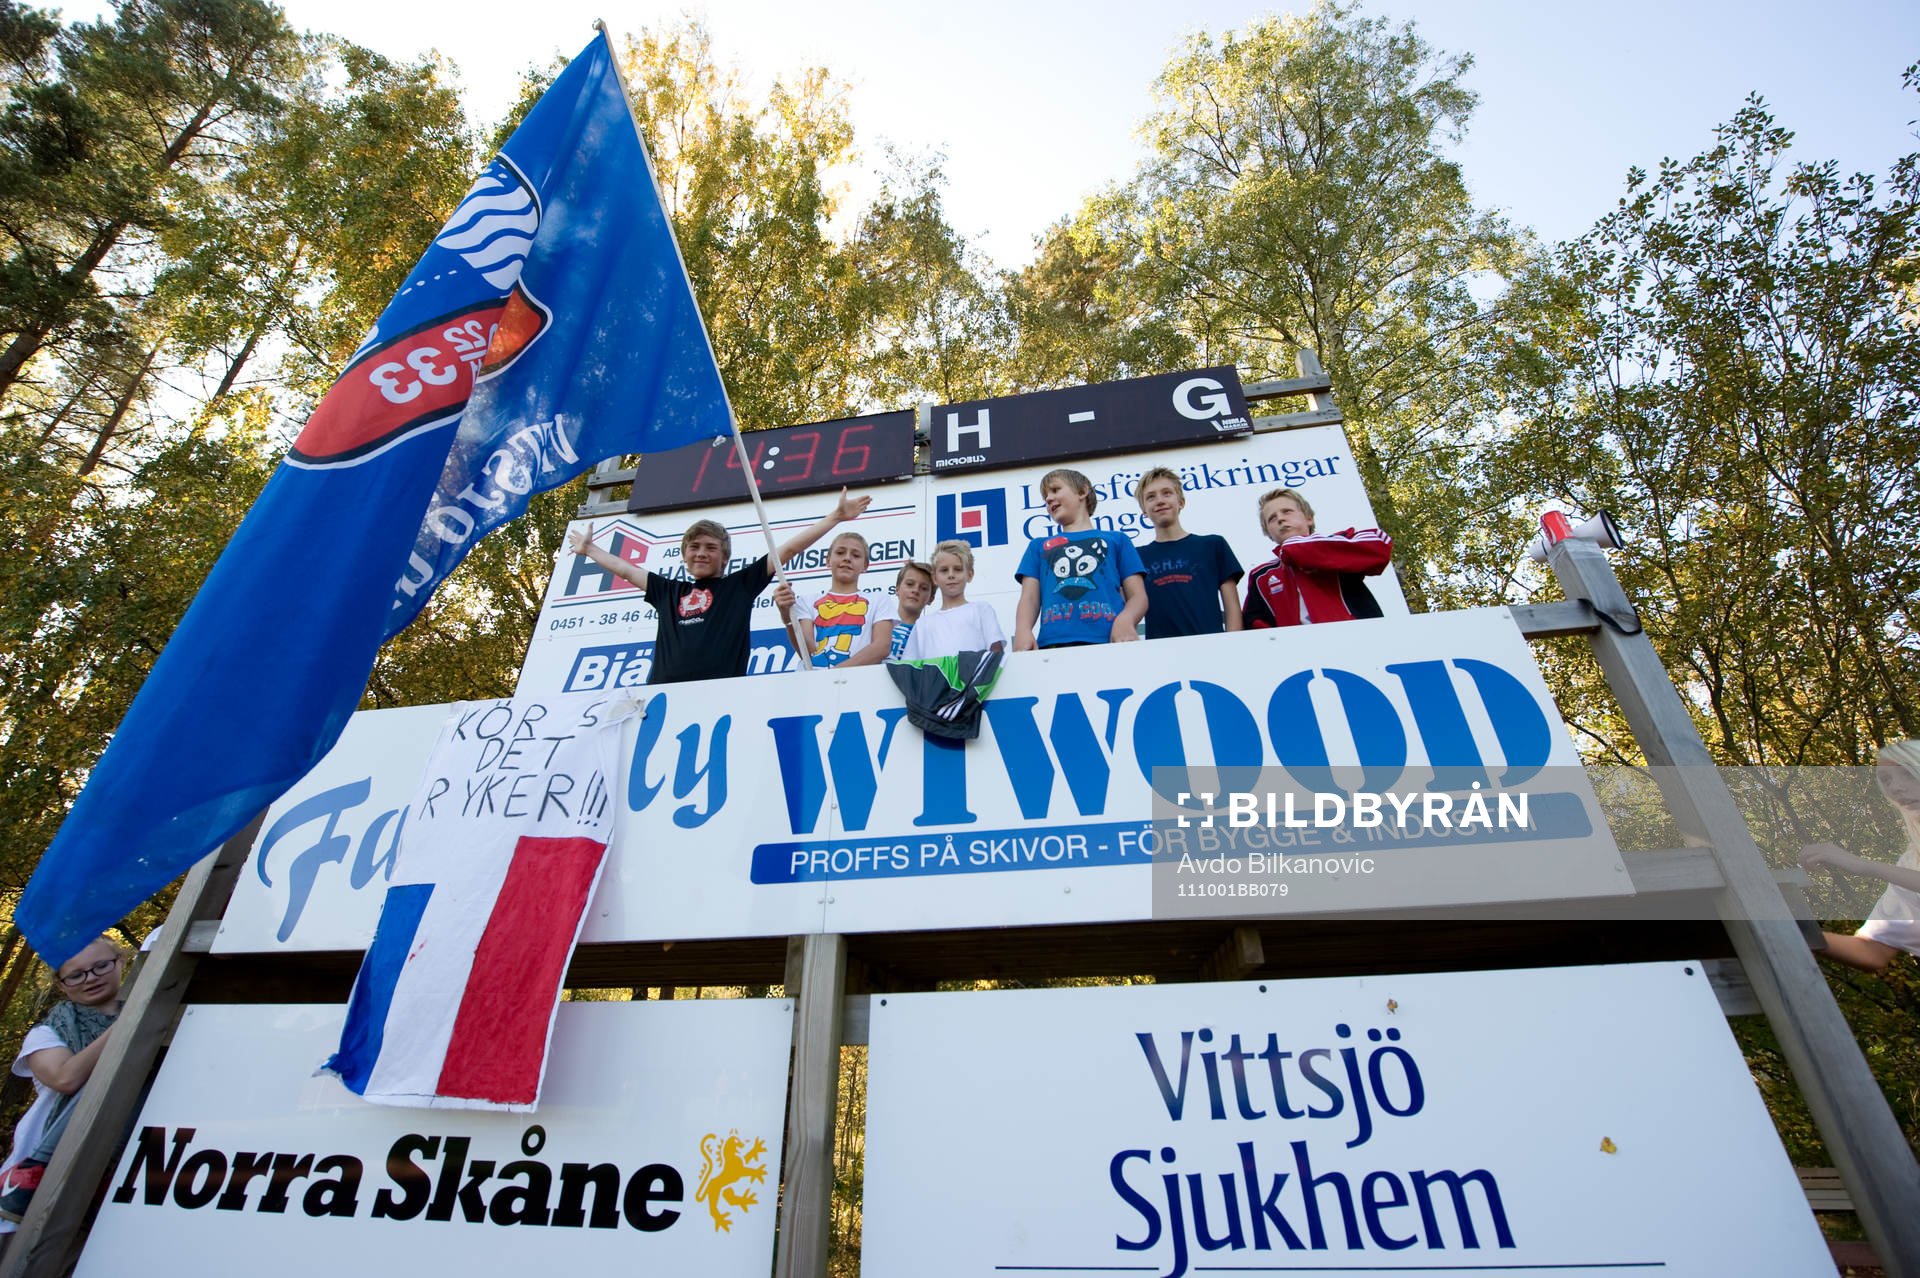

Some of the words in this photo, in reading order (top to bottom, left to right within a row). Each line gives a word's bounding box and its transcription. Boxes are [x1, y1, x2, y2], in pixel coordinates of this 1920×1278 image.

[947, 408, 991, 453] H
[1172, 377, 1232, 421] G
[1020, 455, 1341, 511] Lsföäkringar
[663, 547, 681, 559] AB
[550, 616, 584, 631] 0451
[599, 613, 617, 625] 38
[621, 610, 640, 622] 46
[451, 700, 548, 743] KÖR
[578, 700, 608, 728] S
[767, 658, 1552, 835] WIWOOD
[476, 735, 576, 773] DET
[790, 844, 910, 875] PROFFS
[920, 835, 960, 868] PÅ
[968, 834, 1089, 865] SKIVOR
[1118, 824, 1189, 857] FÖR
[1198, 818, 1322, 854] BYGGE
[1135, 1023, 1426, 1149] Vittsjö
[112, 1125, 361, 1217] Norra
[371, 1124, 685, 1233] Skåne
[1108, 1140, 1517, 1278] Sjukhem
